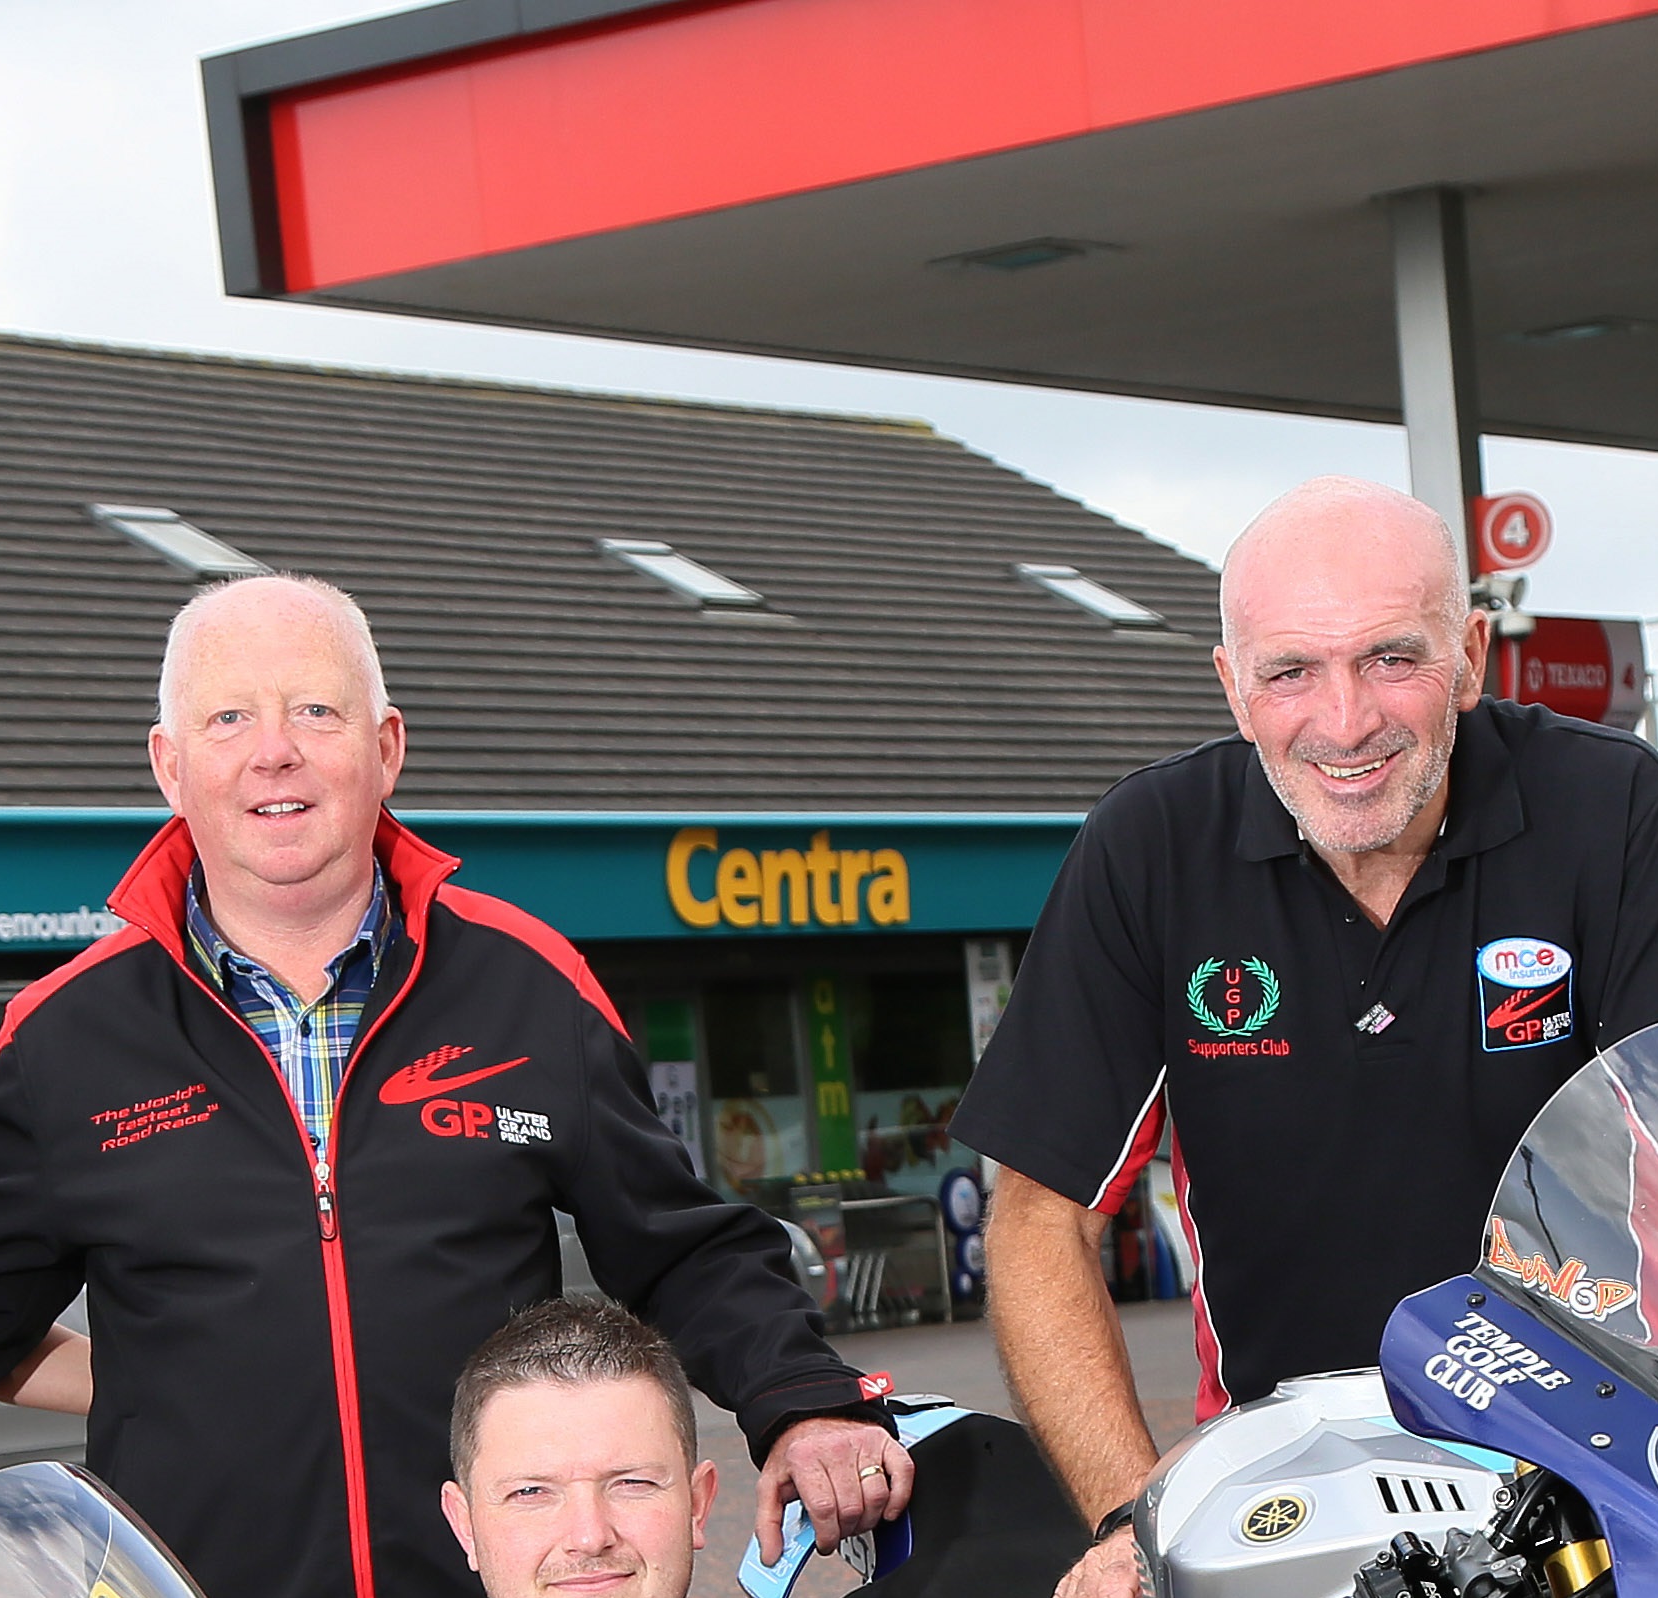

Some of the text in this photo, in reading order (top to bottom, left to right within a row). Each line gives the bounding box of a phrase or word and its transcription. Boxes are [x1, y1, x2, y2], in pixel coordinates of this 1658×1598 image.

[1501, 510, 1531, 548] 4
[1546, 661, 1608, 689] TEXACO
[666, 826, 911, 929] Centra
[1494, 948, 1555, 973] mce
[1508, 964, 1563, 980] insurance
[1505, 1018, 1543, 1043] GP
[1187, 1038, 1291, 1059] Supporters Club
[89, 1108, 131, 1125] The
[115, 1102, 191, 1136] Fastest
[420, 1098, 553, 1142] GP GRAND
[495, 1105, 550, 1129] ULSTER
[100, 1124, 153, 1152] Road
[500, 1131, 530, 1145] PRIX
[1444, 1335, 1526, 1388] GOLF
[1455, 1311, 1572, 1392] TEMPLE
[1424, 1354, 1497, 1410] CLUB
